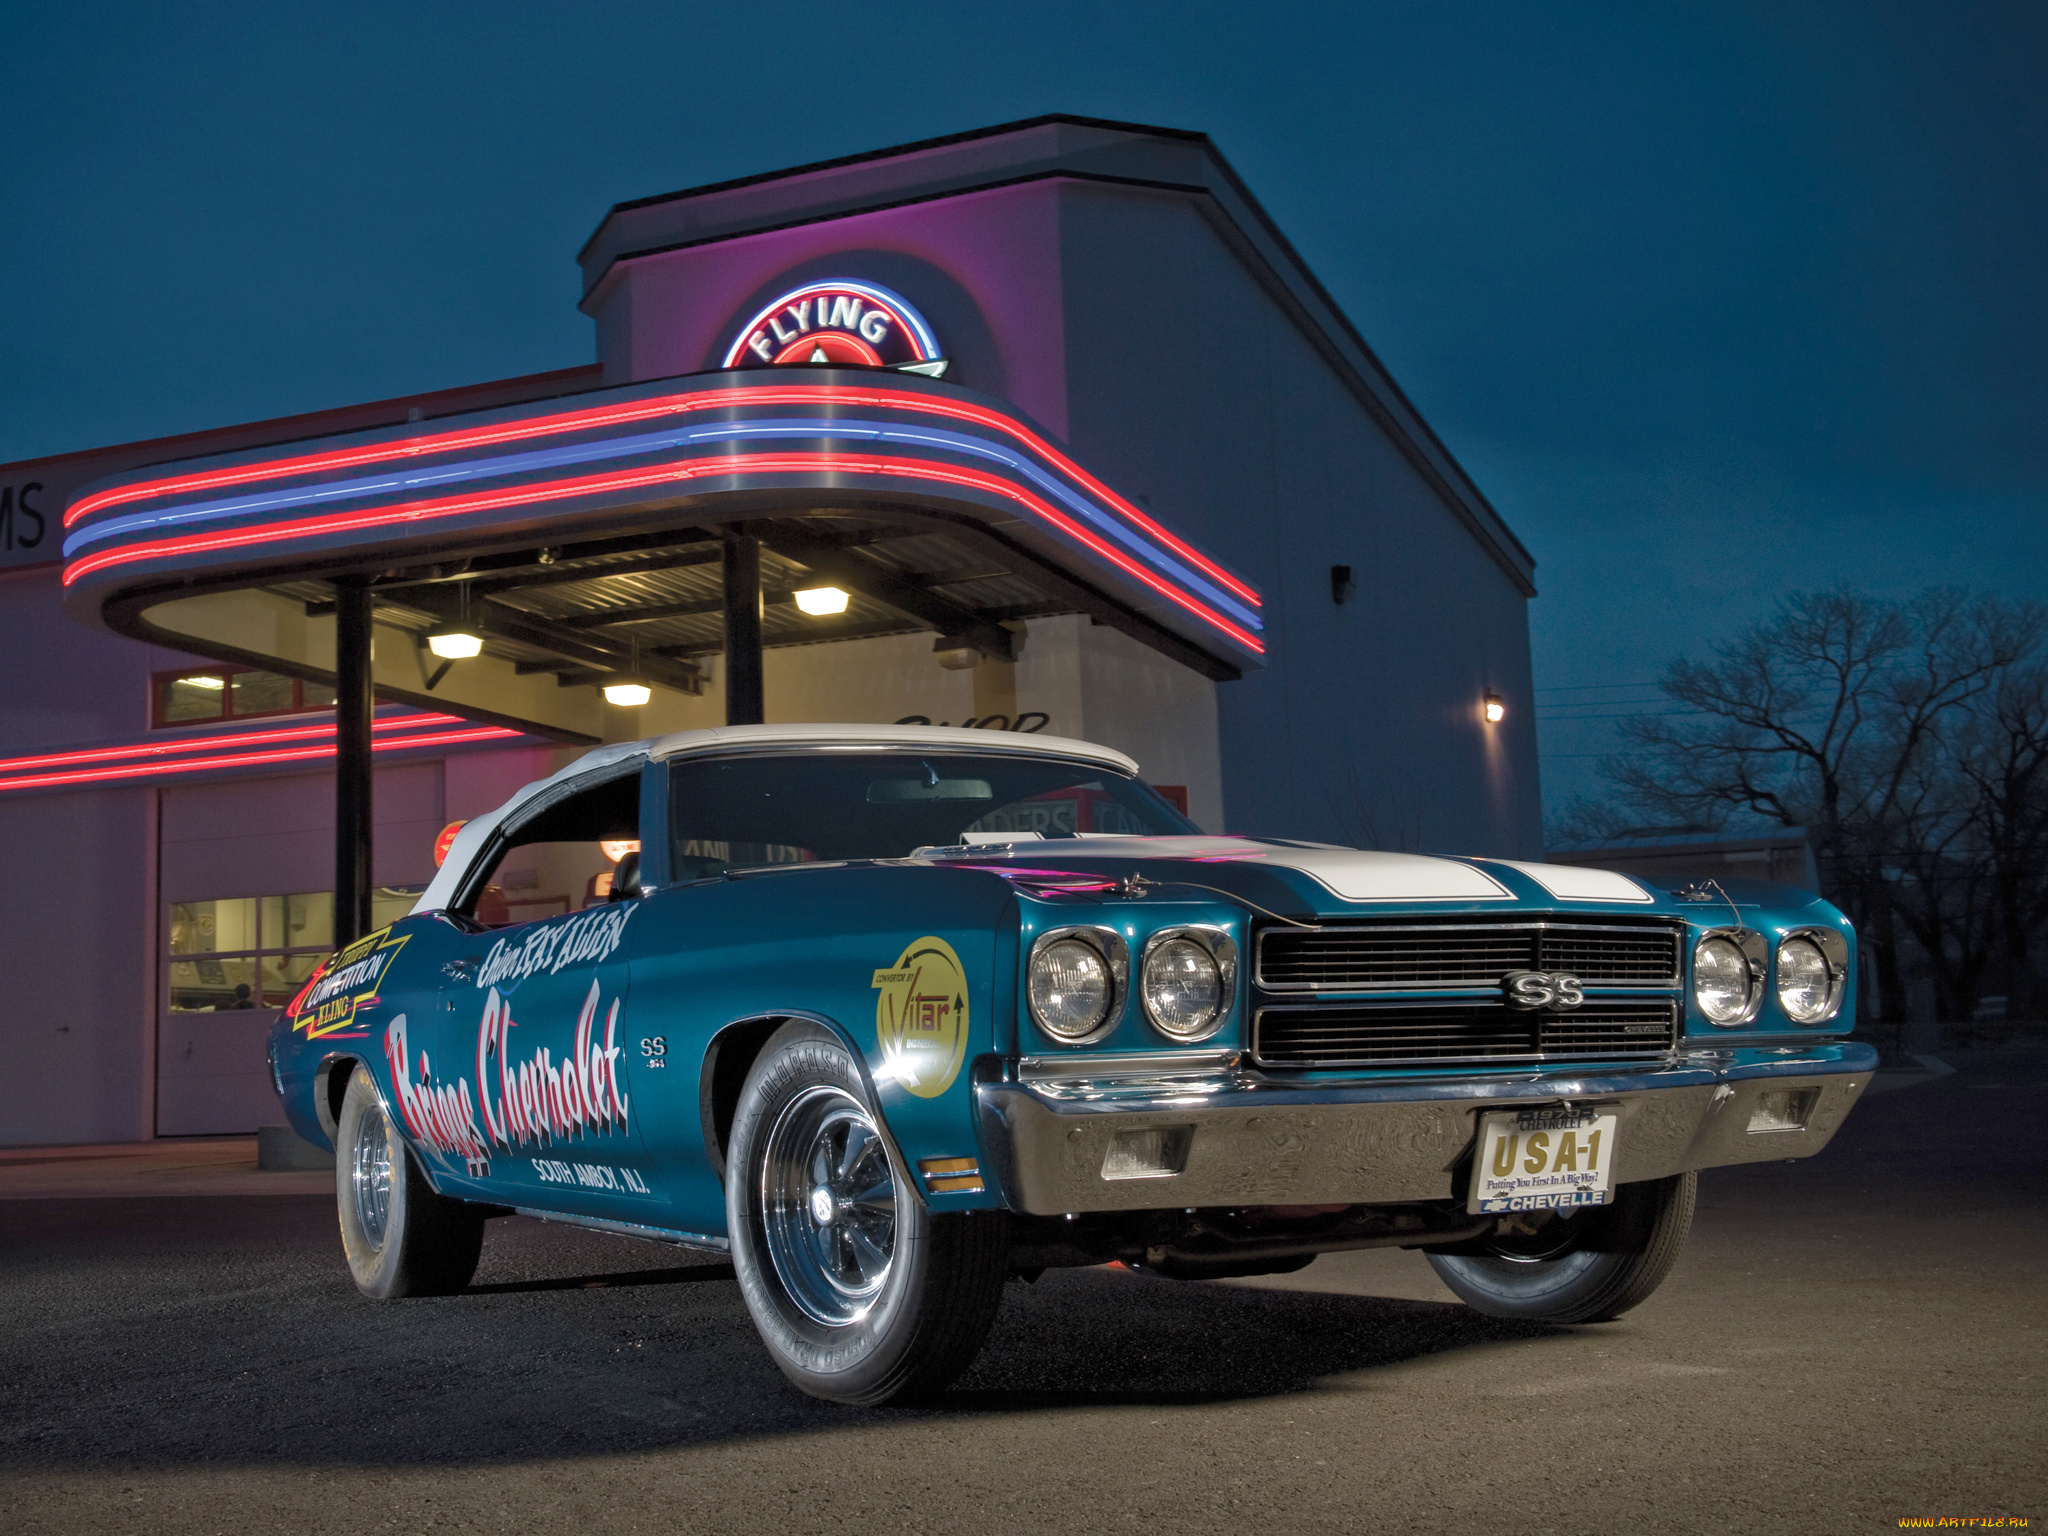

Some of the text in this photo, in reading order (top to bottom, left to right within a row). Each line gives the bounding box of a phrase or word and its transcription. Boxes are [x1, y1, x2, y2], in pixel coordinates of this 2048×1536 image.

[749, 296, 893, 362] FLYING
[512, 916, 577, 980] RAY
[551, 902, 639, 976] ALLEN
[306, 953, 387, 1009] COMPETITION
[875, 973, 915, 984] CONVERTOR BY
[1503, 972, 1584, 1009] SS
[316, 996, 349, 1026] KLING
[888, 966, 950, 1056] Vitar
[640, 1036, 667, 1057] SS
[384, 1013, 491, 1177] Briggs
[476, 977, 629, 1156] Chevrolet
[1520, 1117, 1582, 1132] CHEVROLET
[531, 1158, 651, 1194] SOUTH AMBOY, N.J.
[1486, 1178, 1516, 1191] Putting
[1516, 1177, 1531, 1188] You
[1532, 1176, 1550, 1187] First
[1551, 1175, 1560, 1185] In
[1560, 1174, 1567, 1185] A
[1567, 1173, 1580, 1187] Big
[1509, 1191, 1604, 1211] CHEVELLE
